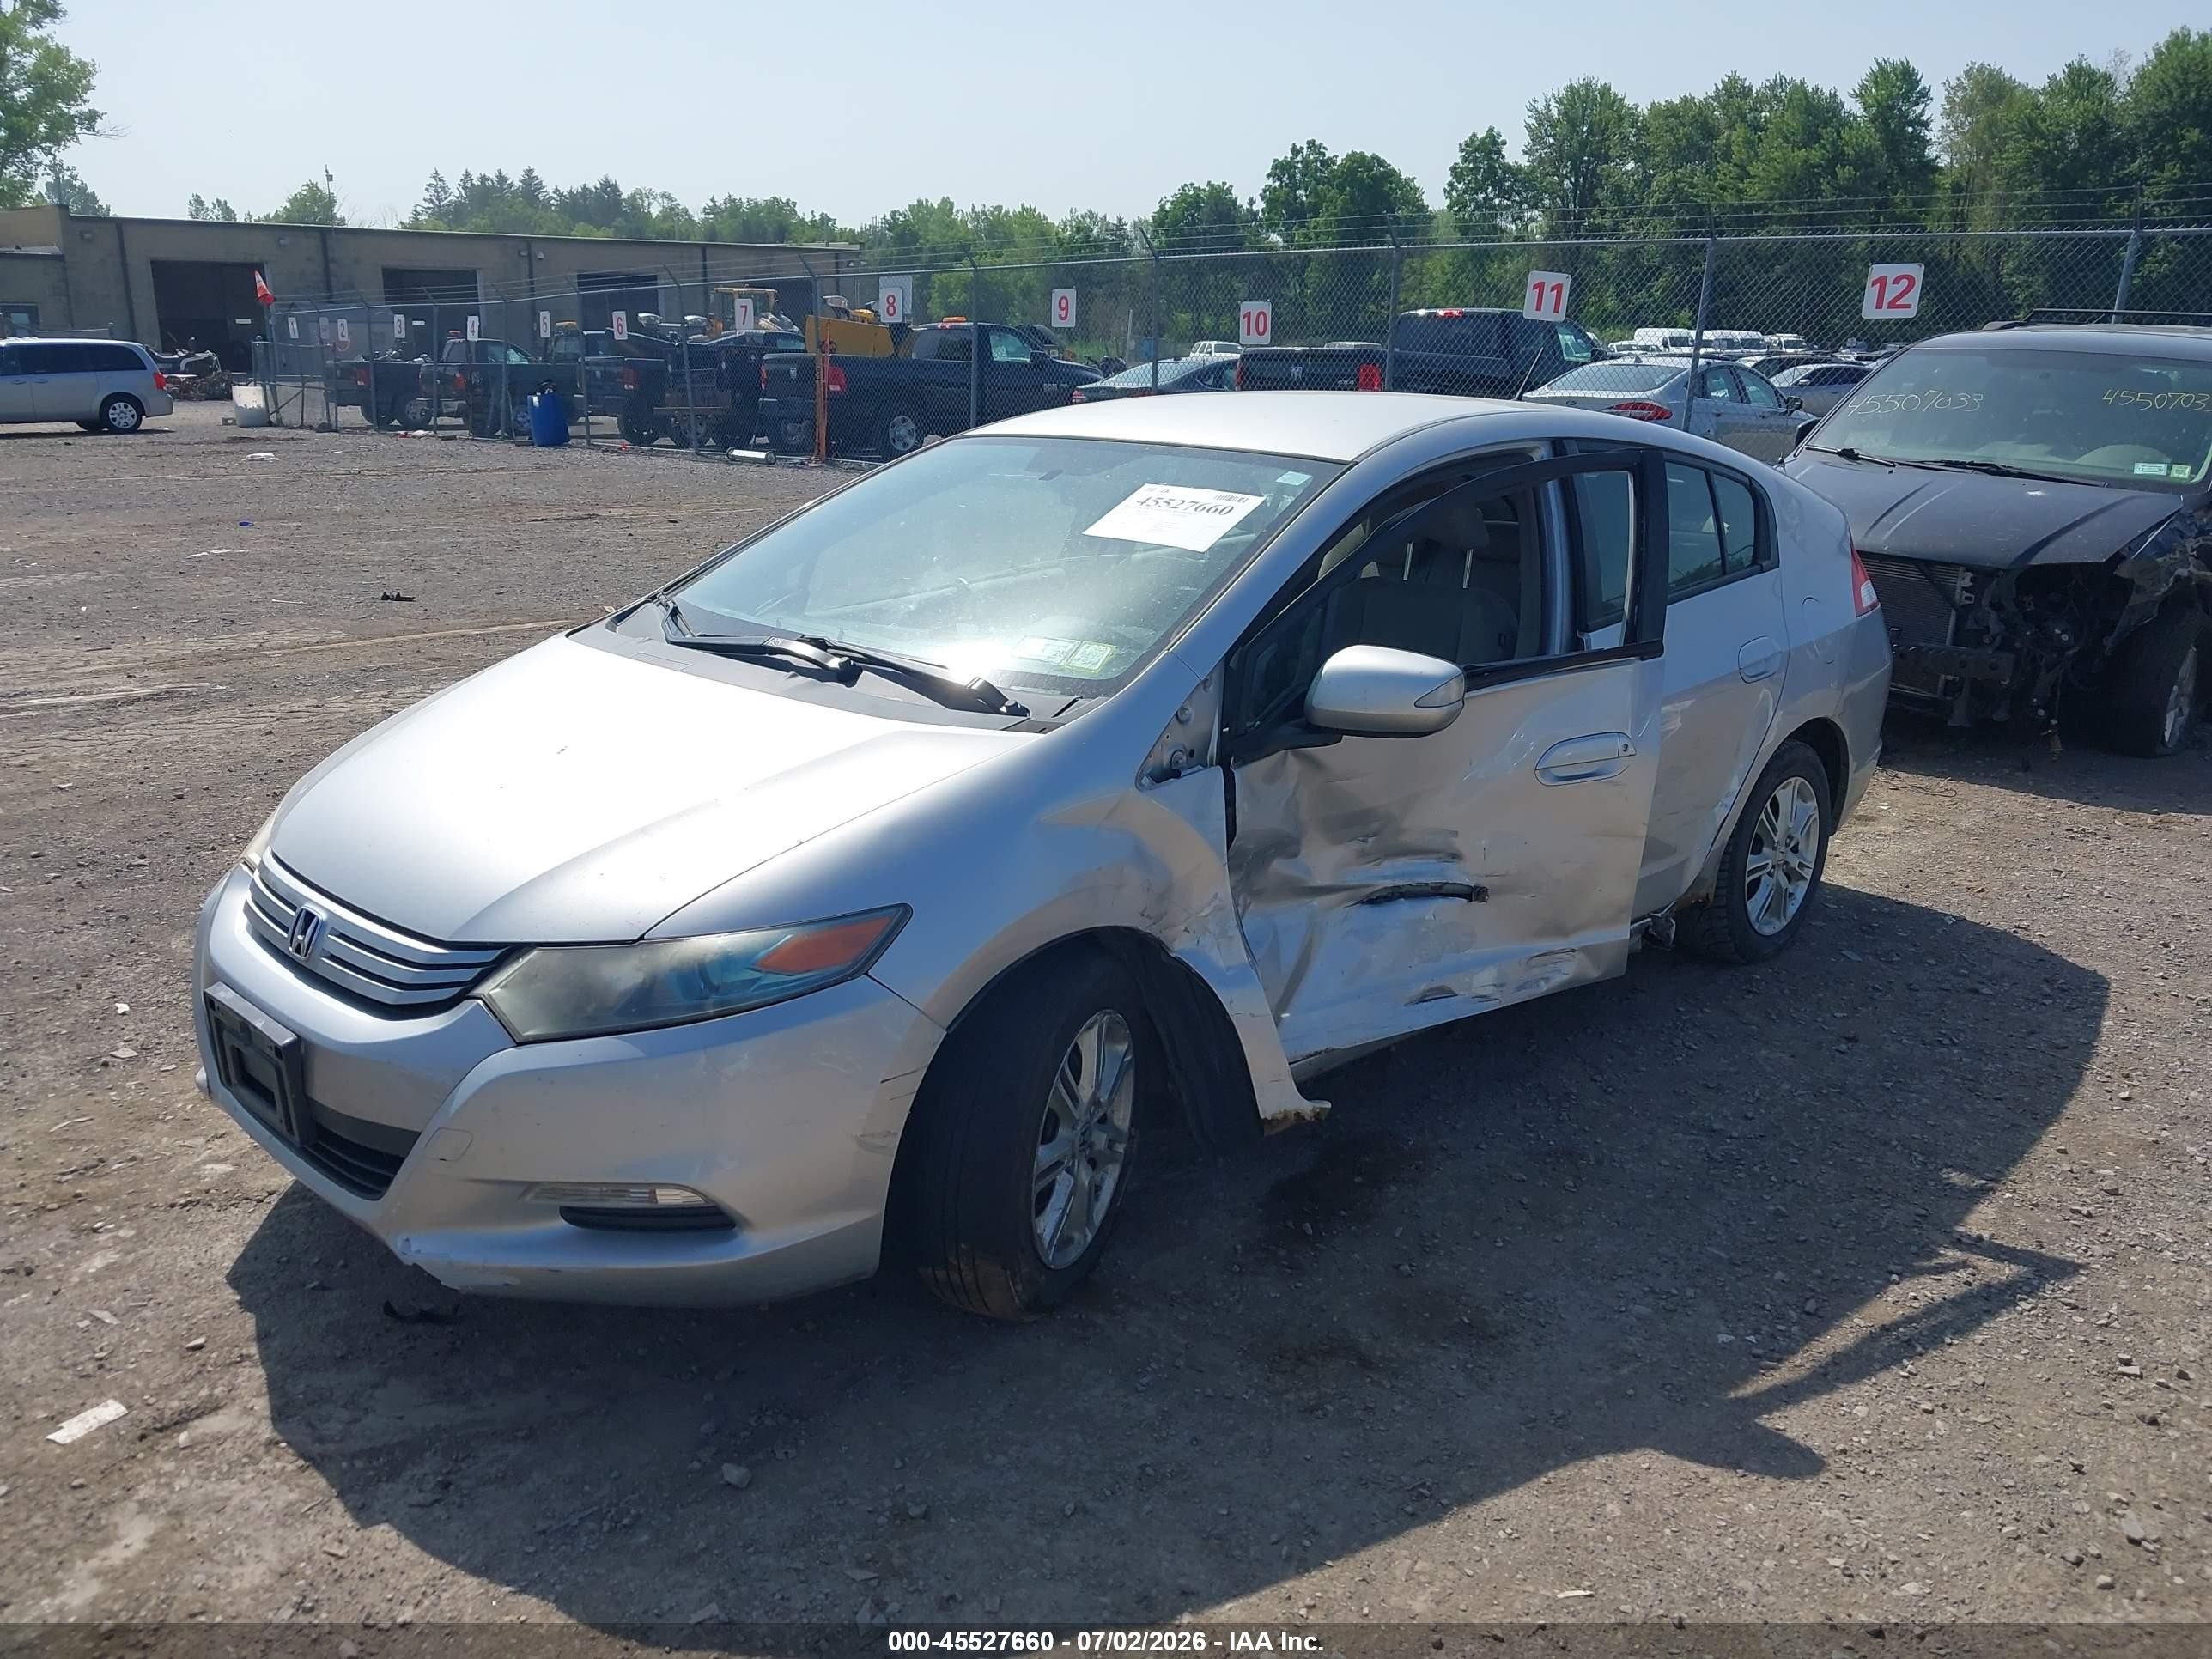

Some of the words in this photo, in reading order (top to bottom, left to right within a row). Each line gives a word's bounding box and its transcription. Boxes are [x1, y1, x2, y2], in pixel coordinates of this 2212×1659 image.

[1531, 281, 1565, 313] 11
[1870, 274, 1917, 310] 12
[740, 305, 748, 325] 7
[885, 294, 896, 317] 8
[1058, 295, 1069, 321] 9
[340, 322, 346, 337] 2
[397, 319, 403, 335] 3
[470, 320, 476, 336] 4
[542, 316, 548, 333] 5
[617, 316, 623, 335] 6
[1243, 311, 1268, 337] 10
[1847, 389, 1984, 417] 45507033
[2102, 389, 2212, 412] 4550703
[1136, 496, 1235, 515] 45527660
